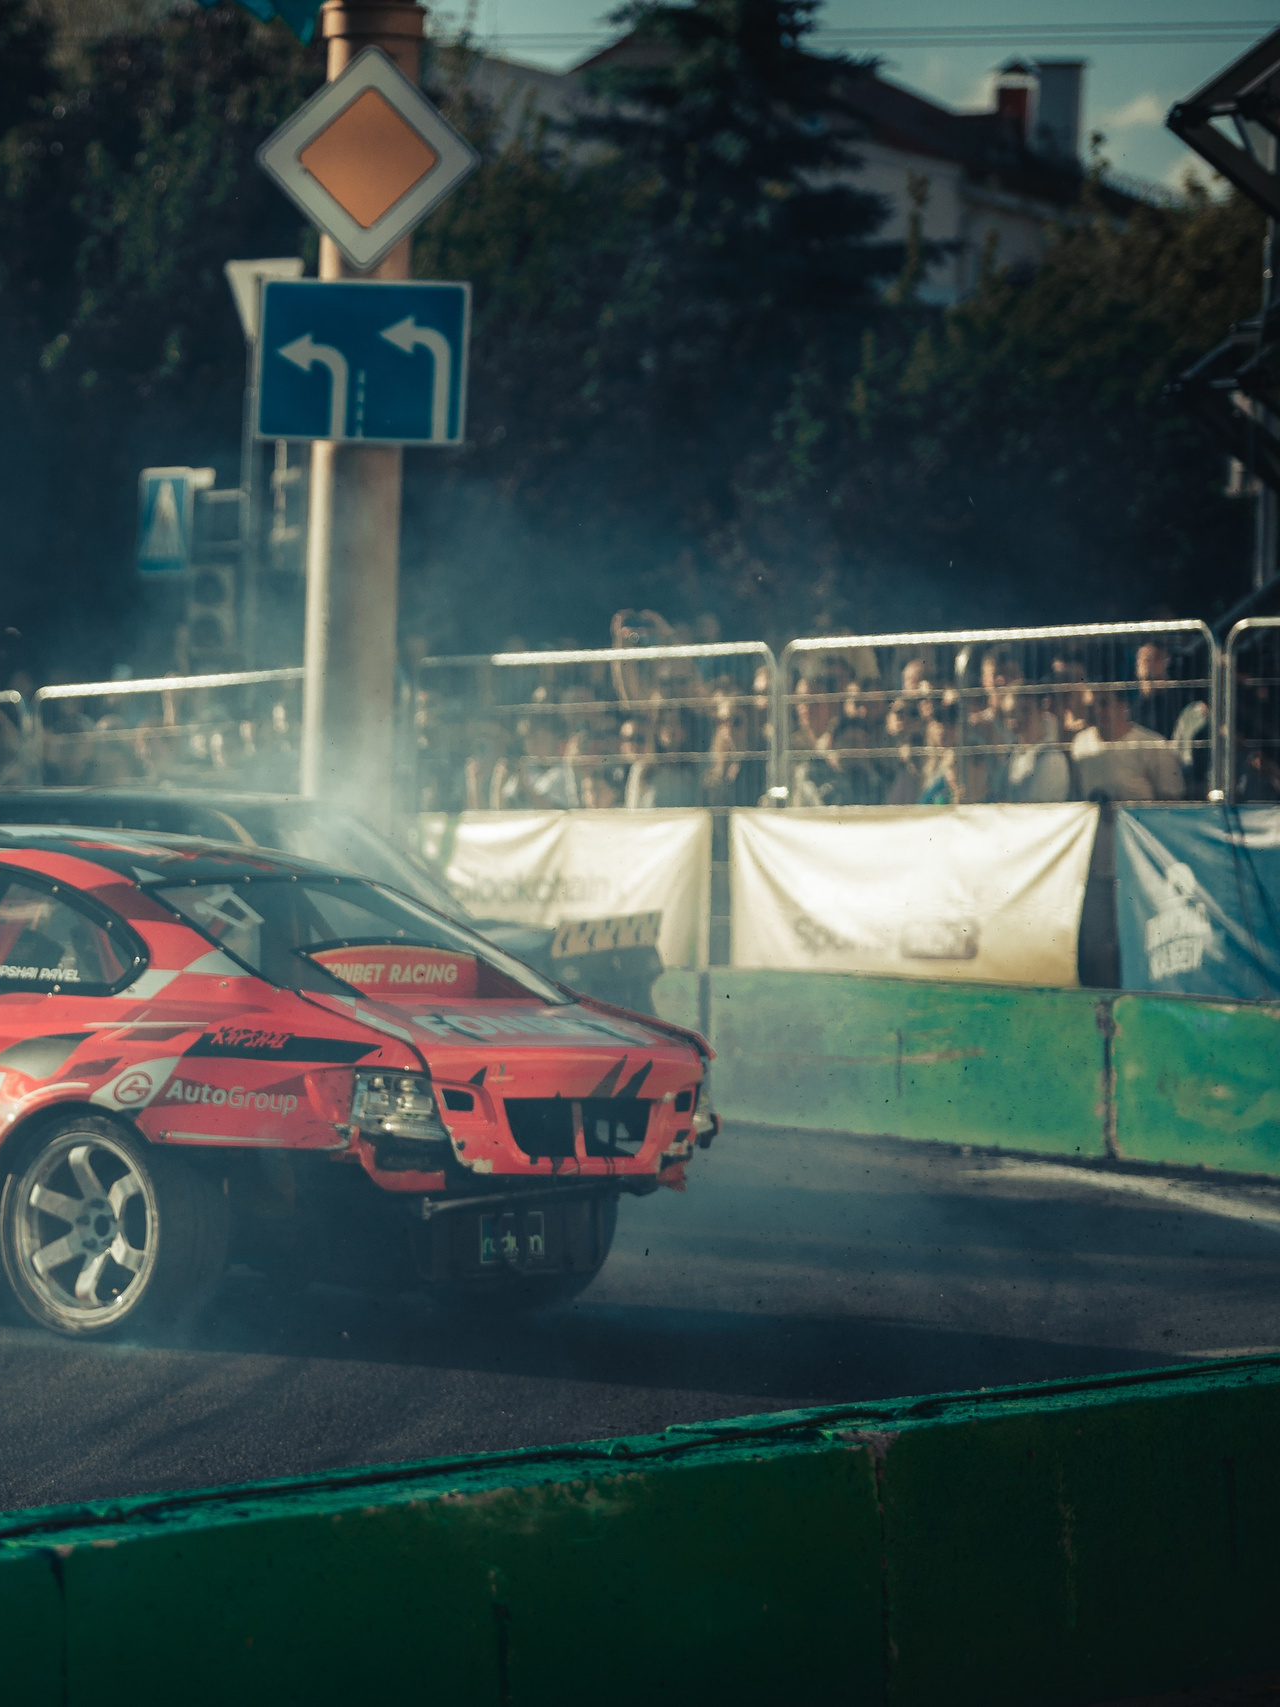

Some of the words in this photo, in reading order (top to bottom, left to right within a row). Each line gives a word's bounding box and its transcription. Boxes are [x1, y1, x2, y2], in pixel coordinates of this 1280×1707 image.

[39, 968, 81, 982] PAVEL
[388, 964, 458, 983] RACING
[165, 1079, 299, 1116] AutoGroup
